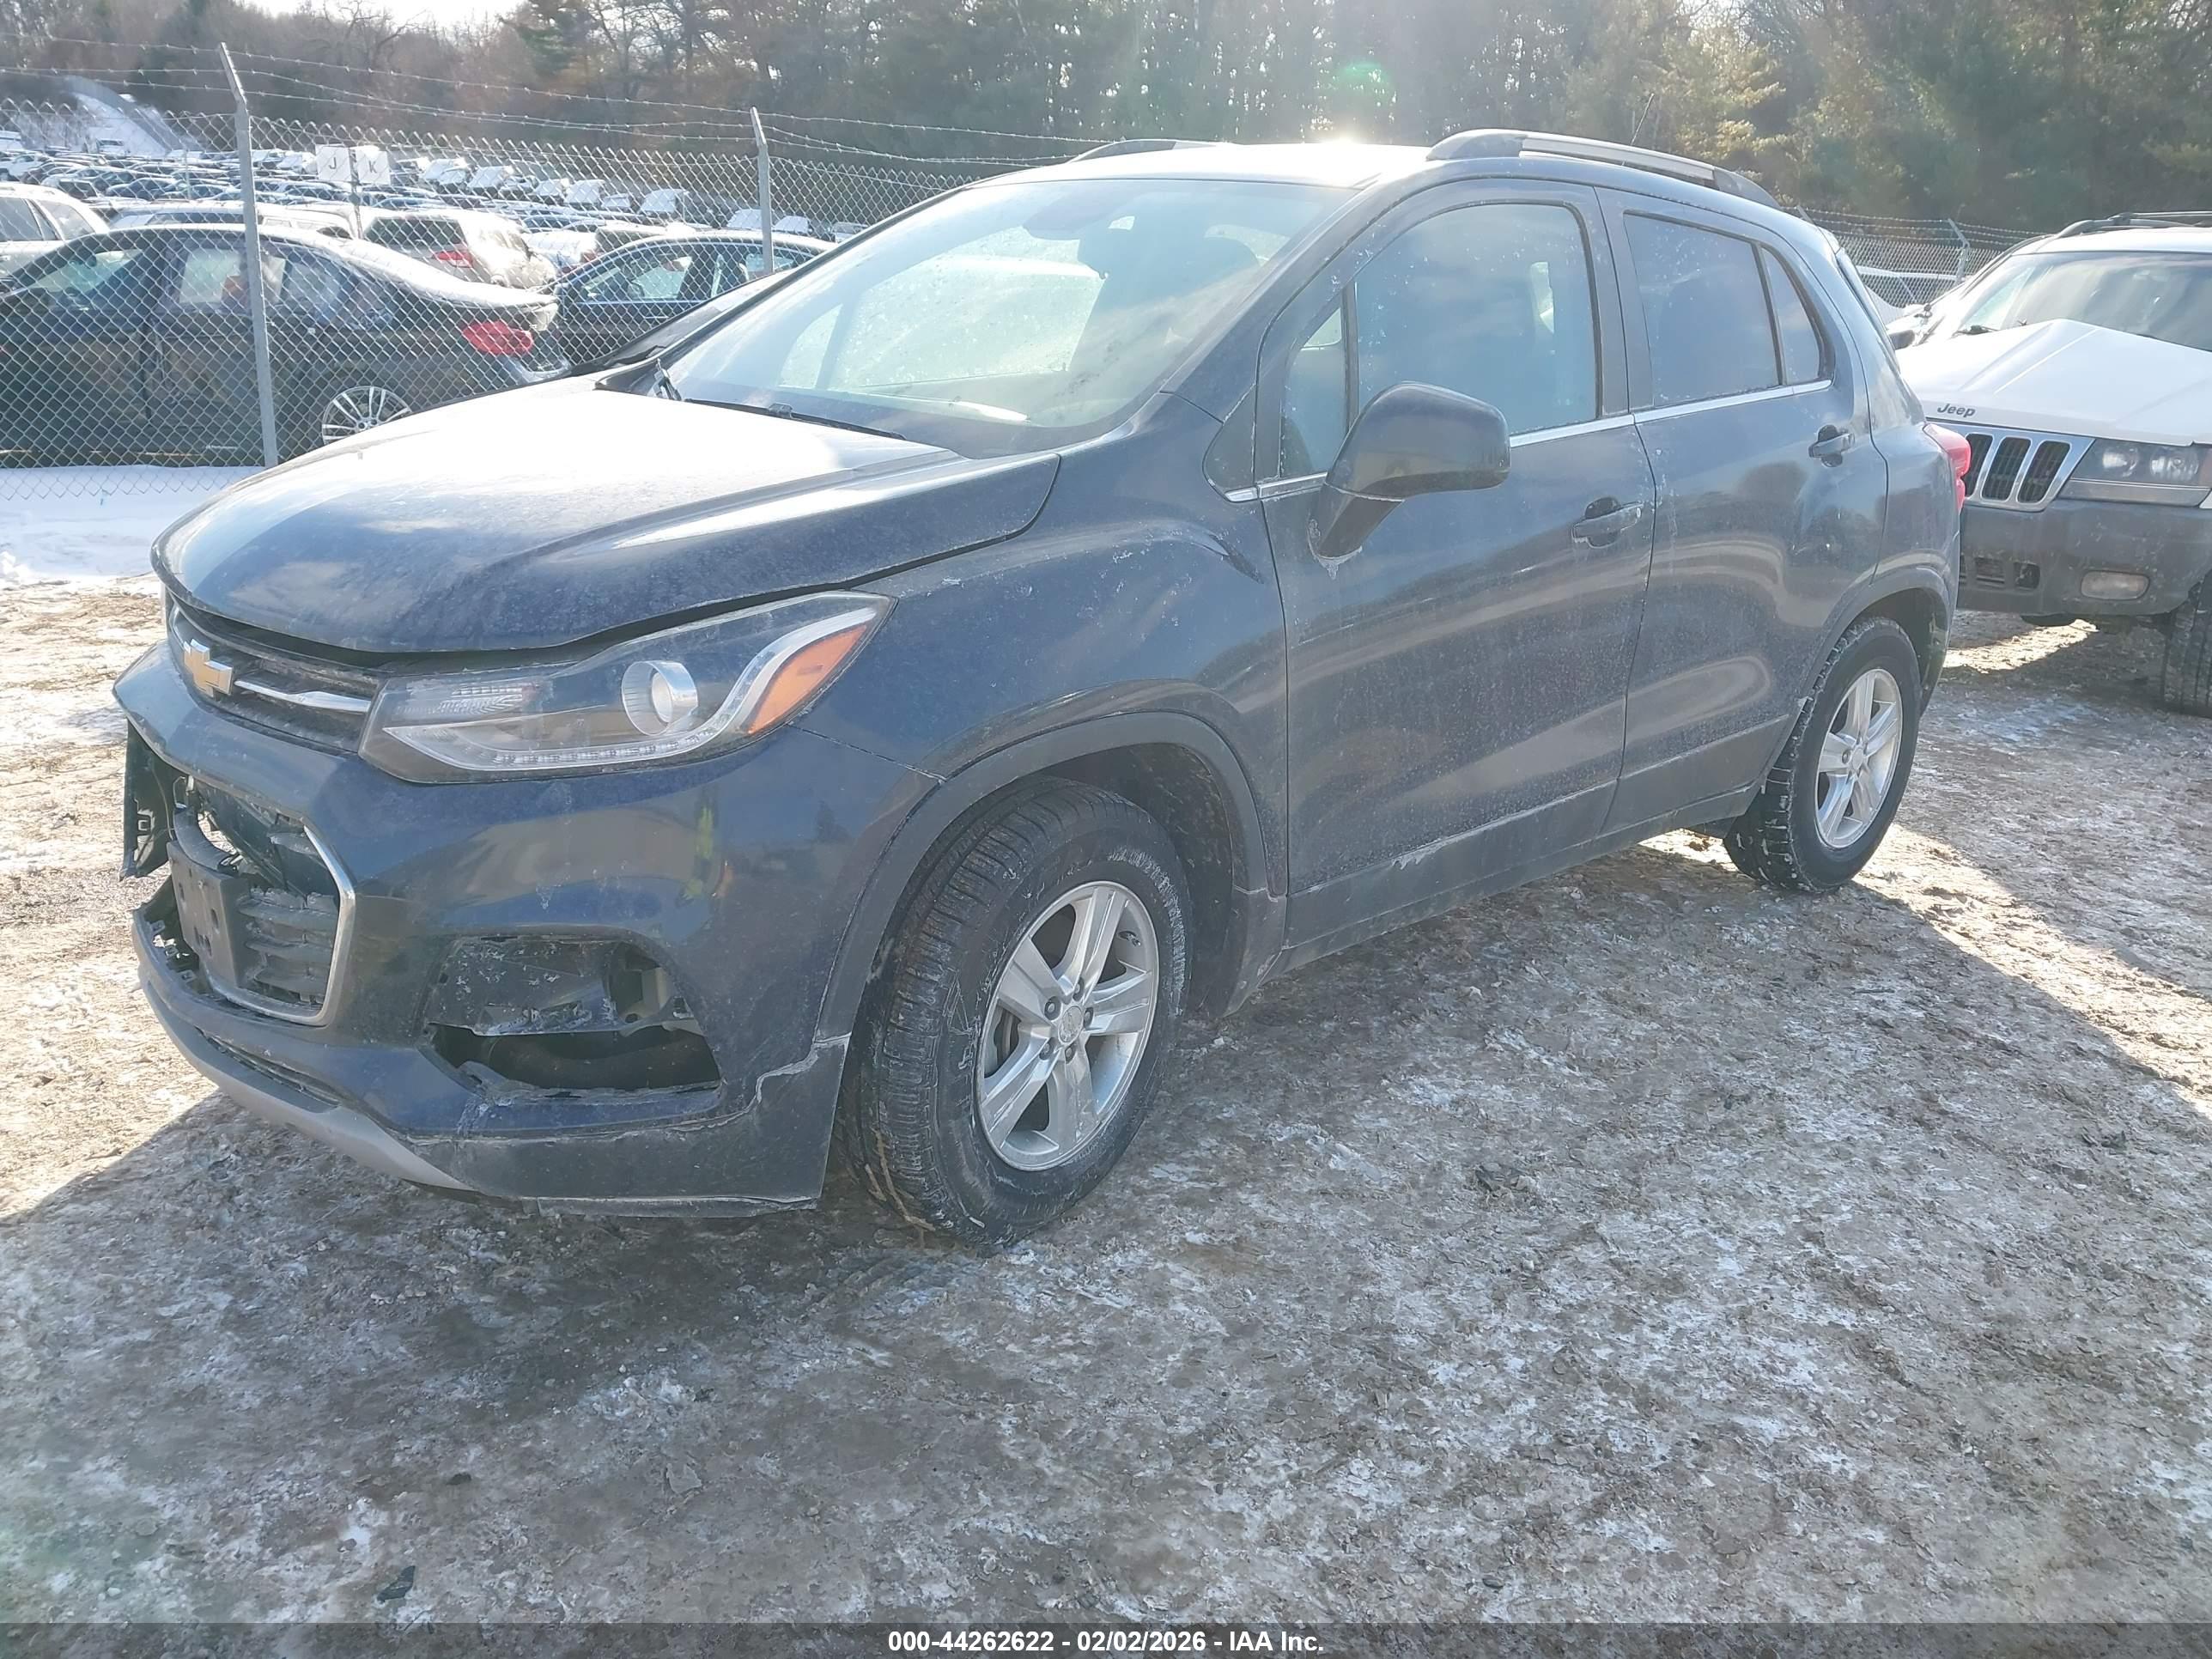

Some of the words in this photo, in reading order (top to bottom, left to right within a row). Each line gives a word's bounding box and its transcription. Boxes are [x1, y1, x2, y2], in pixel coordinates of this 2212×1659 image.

[328, 156, 337, 170] J
[368, 160, 378, 173] K
[1936, 403, 1976, 417] Jeep
